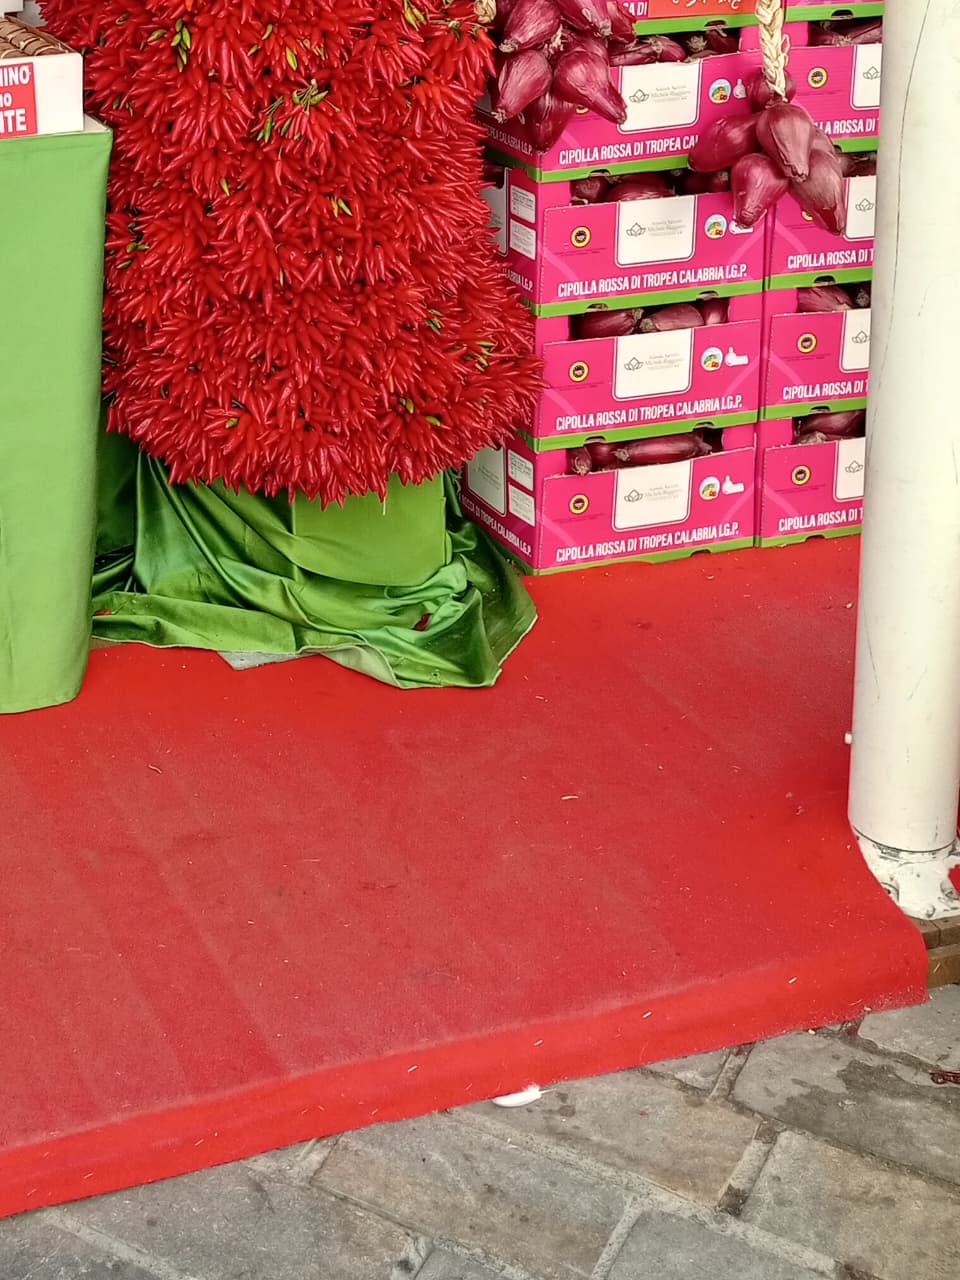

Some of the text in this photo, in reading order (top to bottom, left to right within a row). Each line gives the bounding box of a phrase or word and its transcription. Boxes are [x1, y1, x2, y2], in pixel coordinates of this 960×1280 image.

[833, 119, 864, 134] ROSSA
[866, 118, 875, 132] DI
[559, 147, 598, 165] CIPOLLA
[601, 142, 632, 160] ROSSA
[634, 141, 644, 156] DI
[645, 138, 681, 154] TROPEA
[788, 252, 825, 269] CIPOLLA
[827, 249, 857, 265] ROSSA
[858, 248, 868, 262] DI
[558, 263, 748, 298] CIPOLLA ROSSA DI TROPEA CALABRIA I.G.P.
[782, 383, 820, 400] CIPOLLA
[822, 381, 852, 397] ROSSA
[854, 380, 863, 393] DI
[556, 395, 743, 431] CIPOLLA ROSSA DI TROPEA CALABRIA I.G.P.
[778, 516, 815, 532] CIPOLLA
[817, 511, 847, 526] ROSSA
[849, 509, 858, 521] DI
[497, 523, 520, 549] CALABRIA
[556, 522, 739, 562] CIPOLLA ROSSA DI TROPEA CALABRIA I.G.P.
